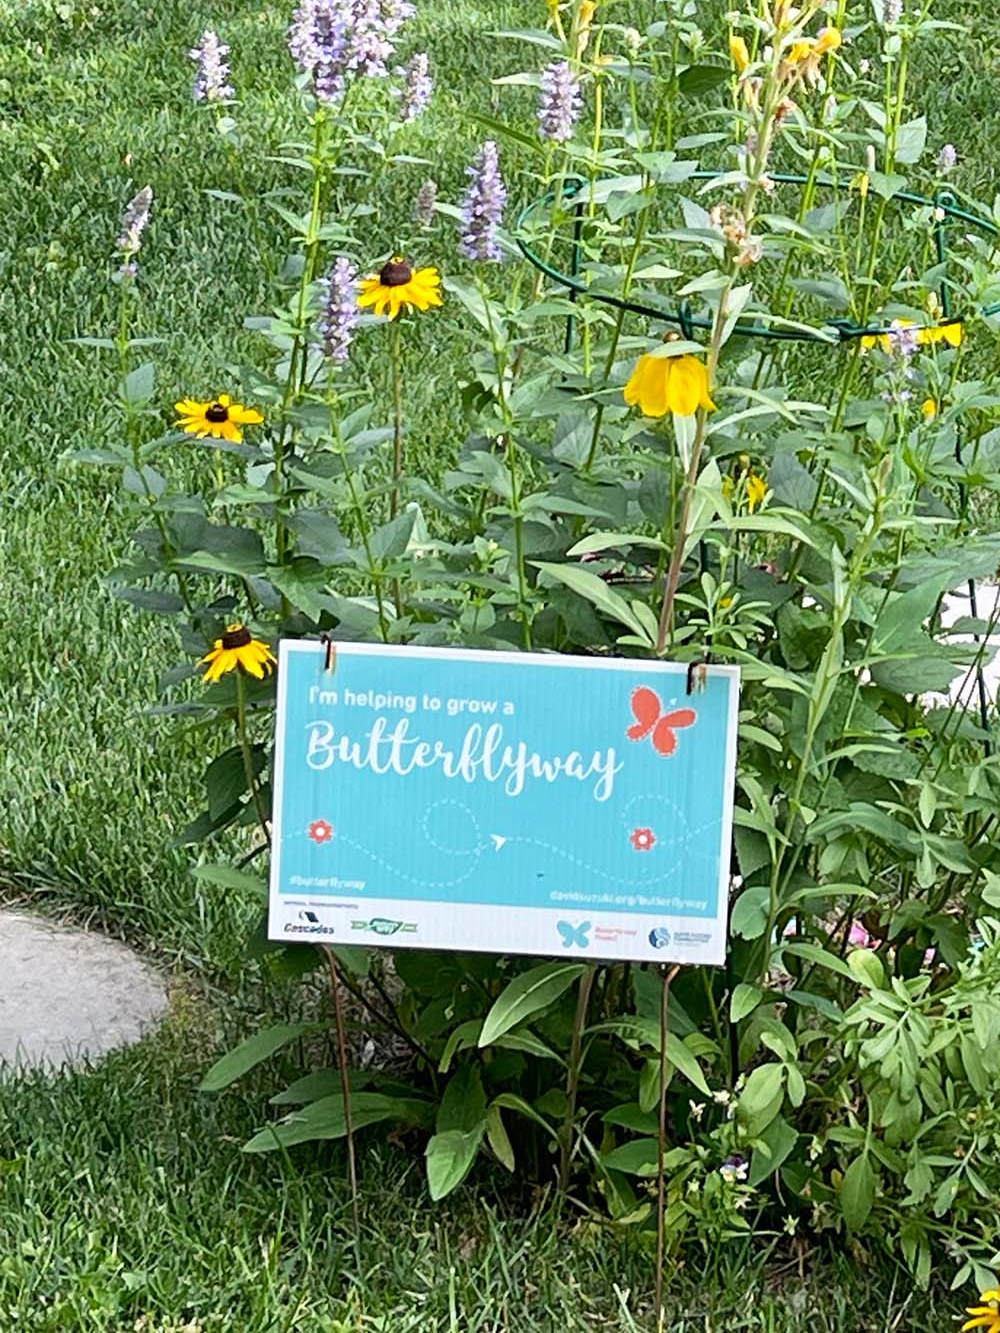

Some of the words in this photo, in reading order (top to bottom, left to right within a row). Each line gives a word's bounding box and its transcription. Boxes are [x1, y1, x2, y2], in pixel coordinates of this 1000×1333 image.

[309, 686, 338, 705] I'm
[345, 688, 417, 713] helping
[423, 693, 441, 711] to
[447, 697, 498, 717] grow
[503, 701, 515, 716] a
[304, 716, 625, 802] Butterflyway
